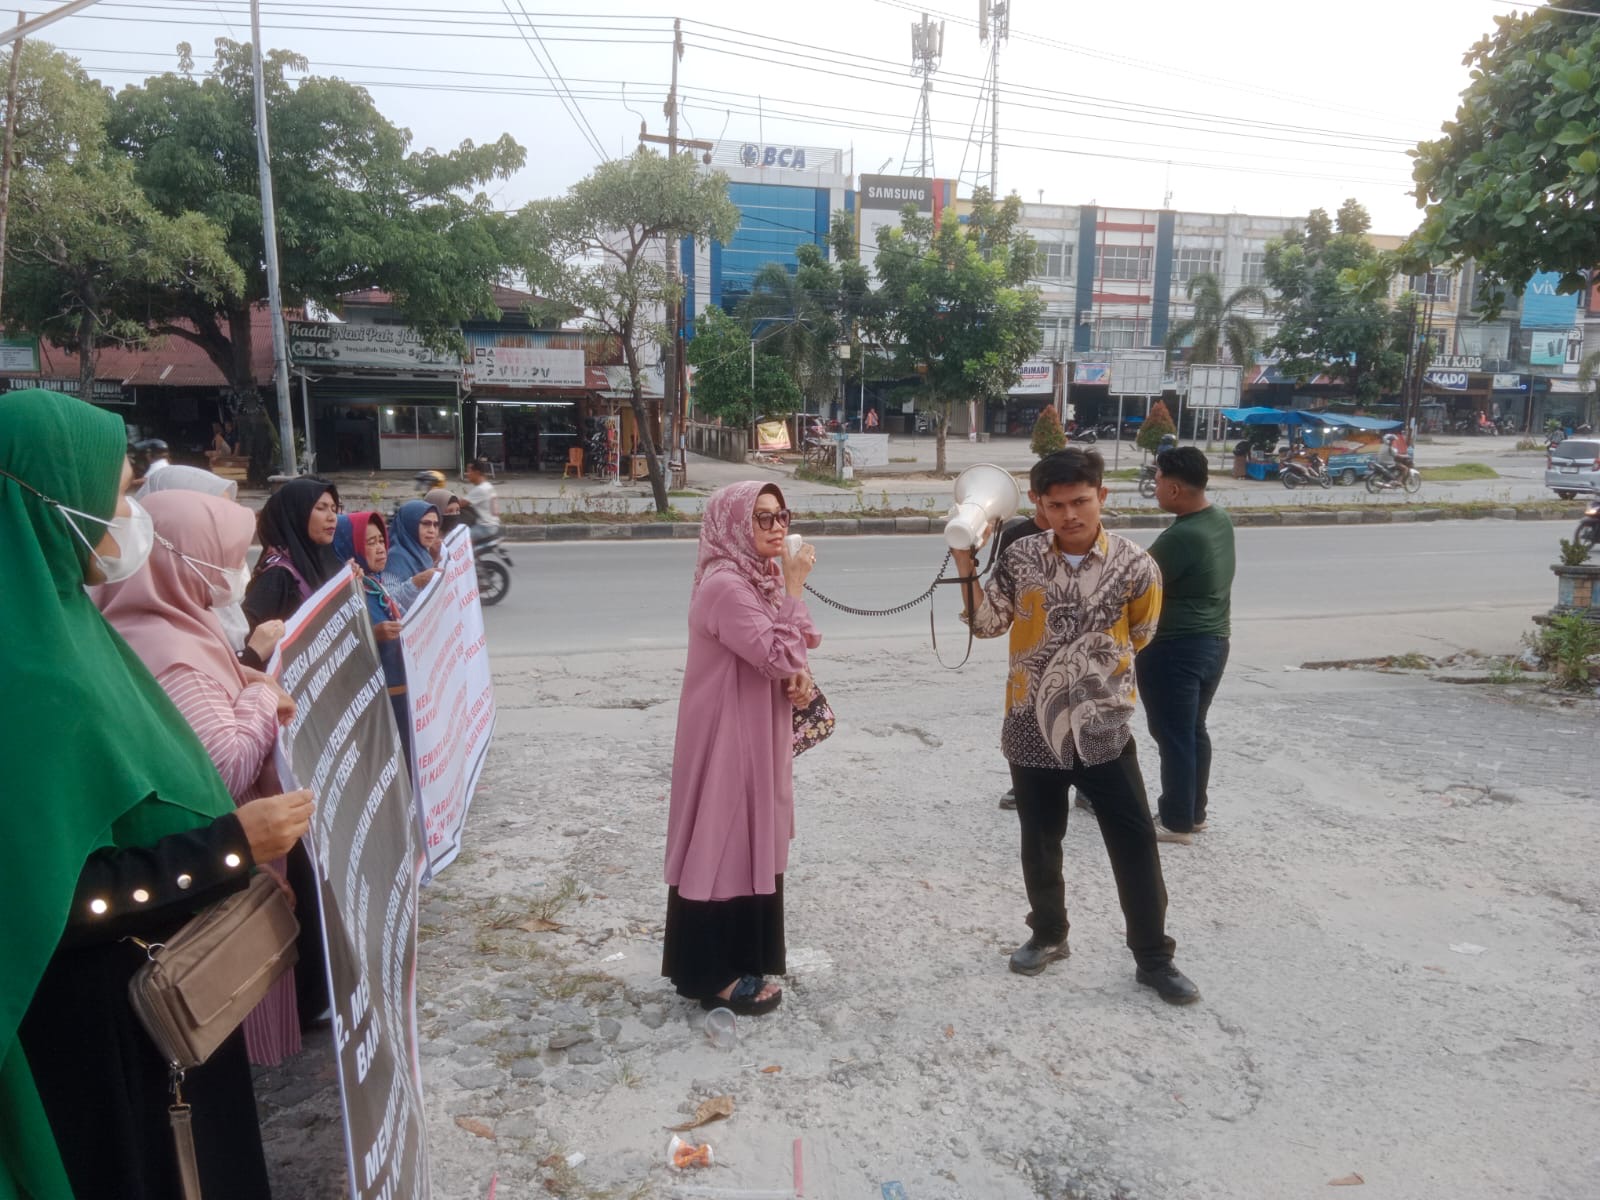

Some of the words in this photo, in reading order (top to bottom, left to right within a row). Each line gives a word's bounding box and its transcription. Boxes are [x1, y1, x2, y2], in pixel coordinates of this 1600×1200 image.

[763, 146, 807, 169] BCA
[868, 186, 925, 201] SAMSUNG
[289, 322, 331, 338] Kadai
[332, 326, 364, 341] Nasi
[365, 328, 394, 342] Pak
[1452, 355, 1482, 368] KADO
[9, 379, 37, 390] TOKO
[1432, 372, 1466, 385] KADO
[350, 682, 375, 719] KARENA
[367, 781, 385, 819] PERDA
